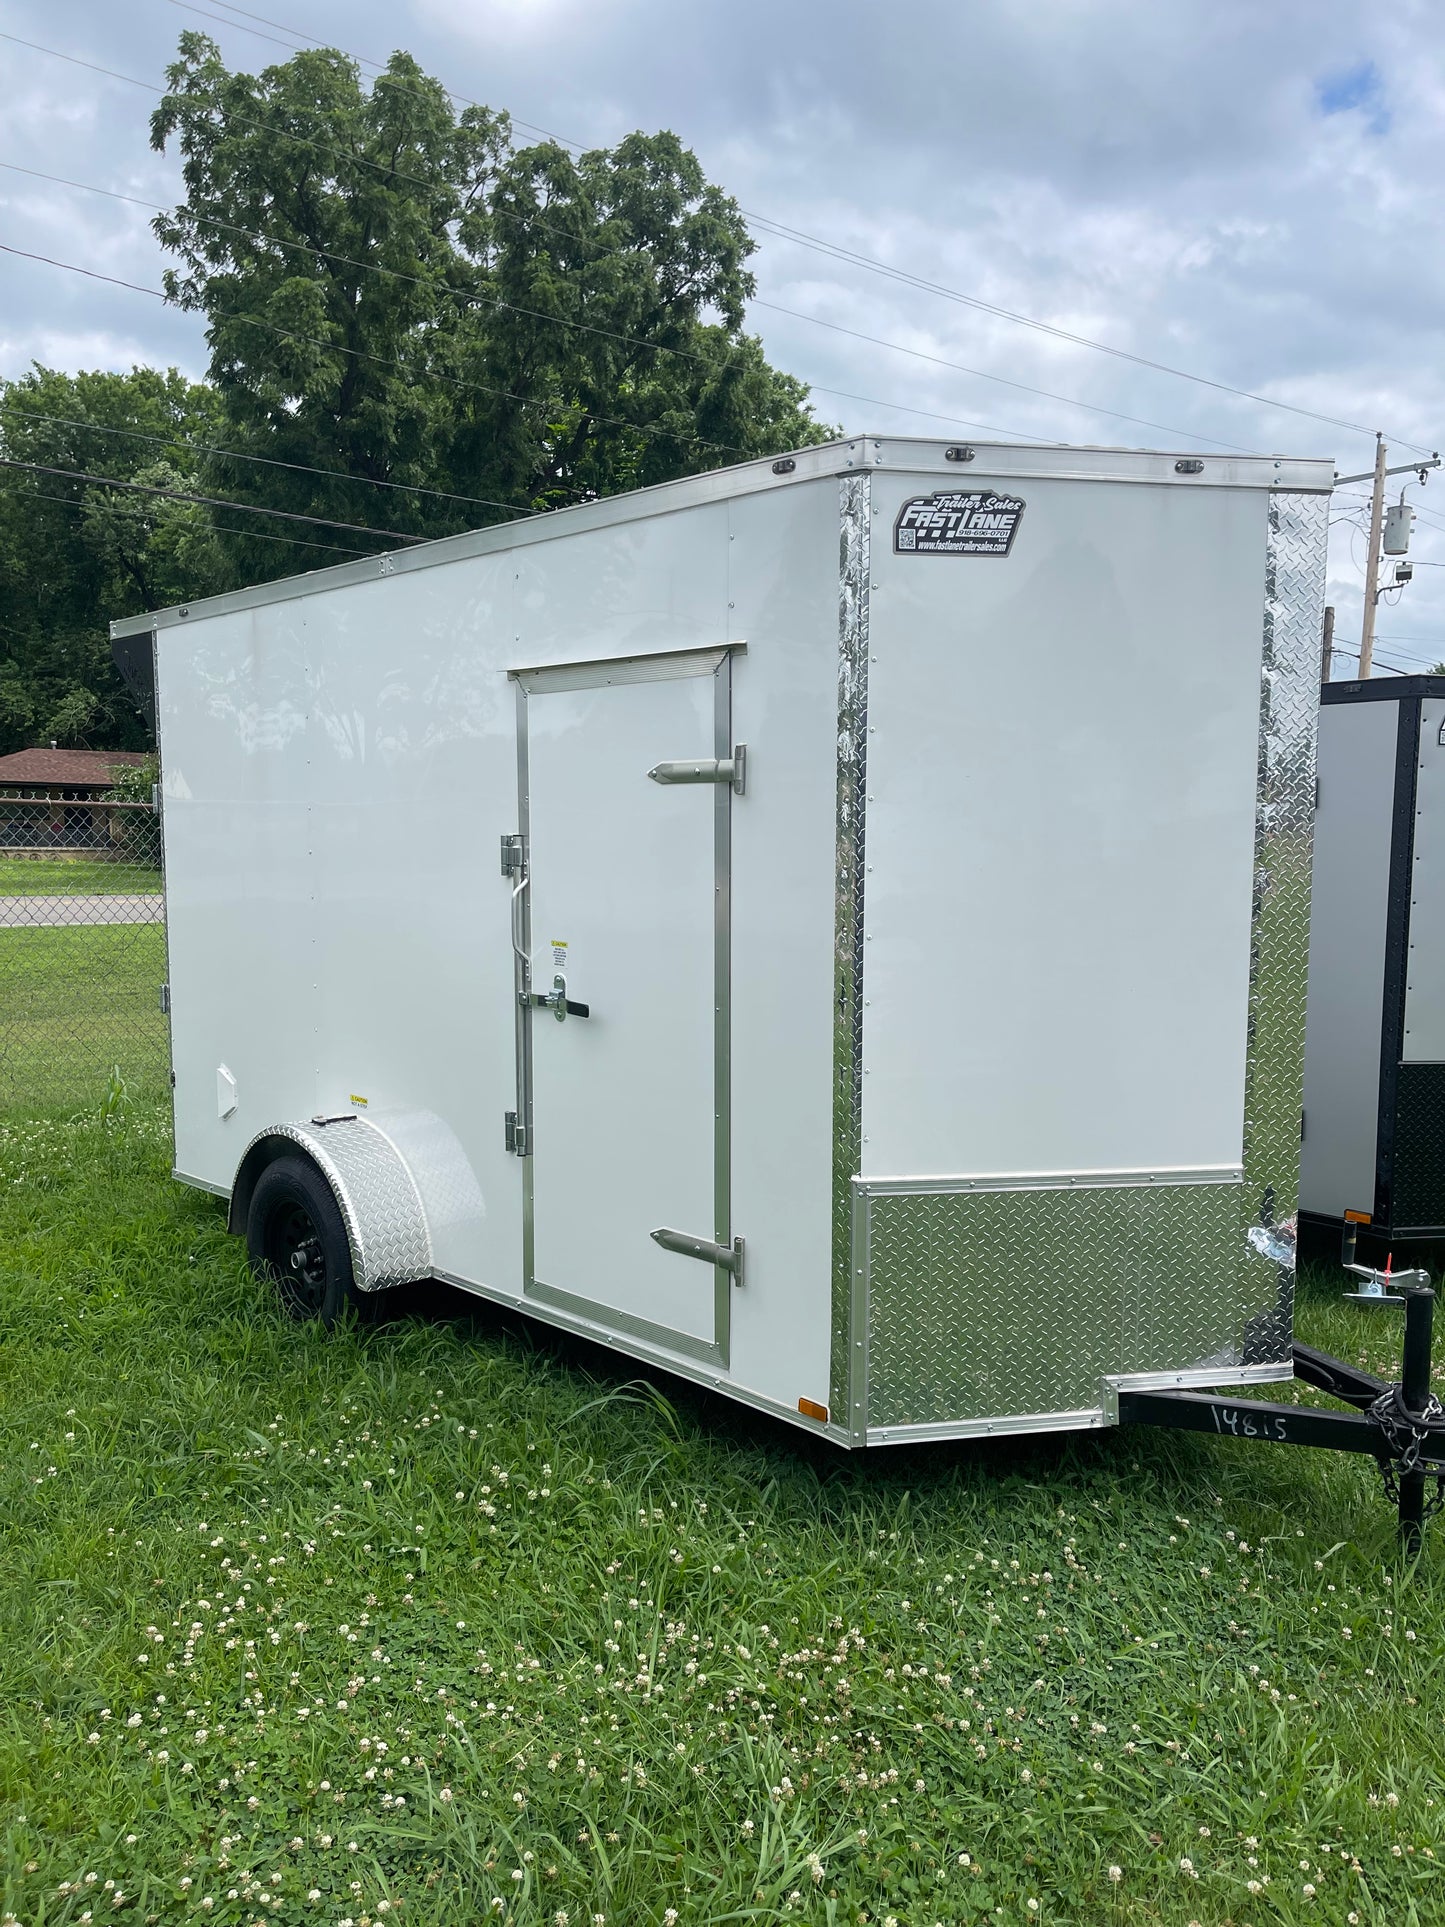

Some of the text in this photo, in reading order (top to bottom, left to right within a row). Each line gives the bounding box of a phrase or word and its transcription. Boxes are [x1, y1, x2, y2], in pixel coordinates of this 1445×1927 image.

[936, 496, 1022, 511] Trailer Sales
[958, 529, 1009, 537] 918-696-0701
[918, 540, 1007, 551] www.fastlanetrailersales.com
[1211, 1404, 1287, 1439] 14815
